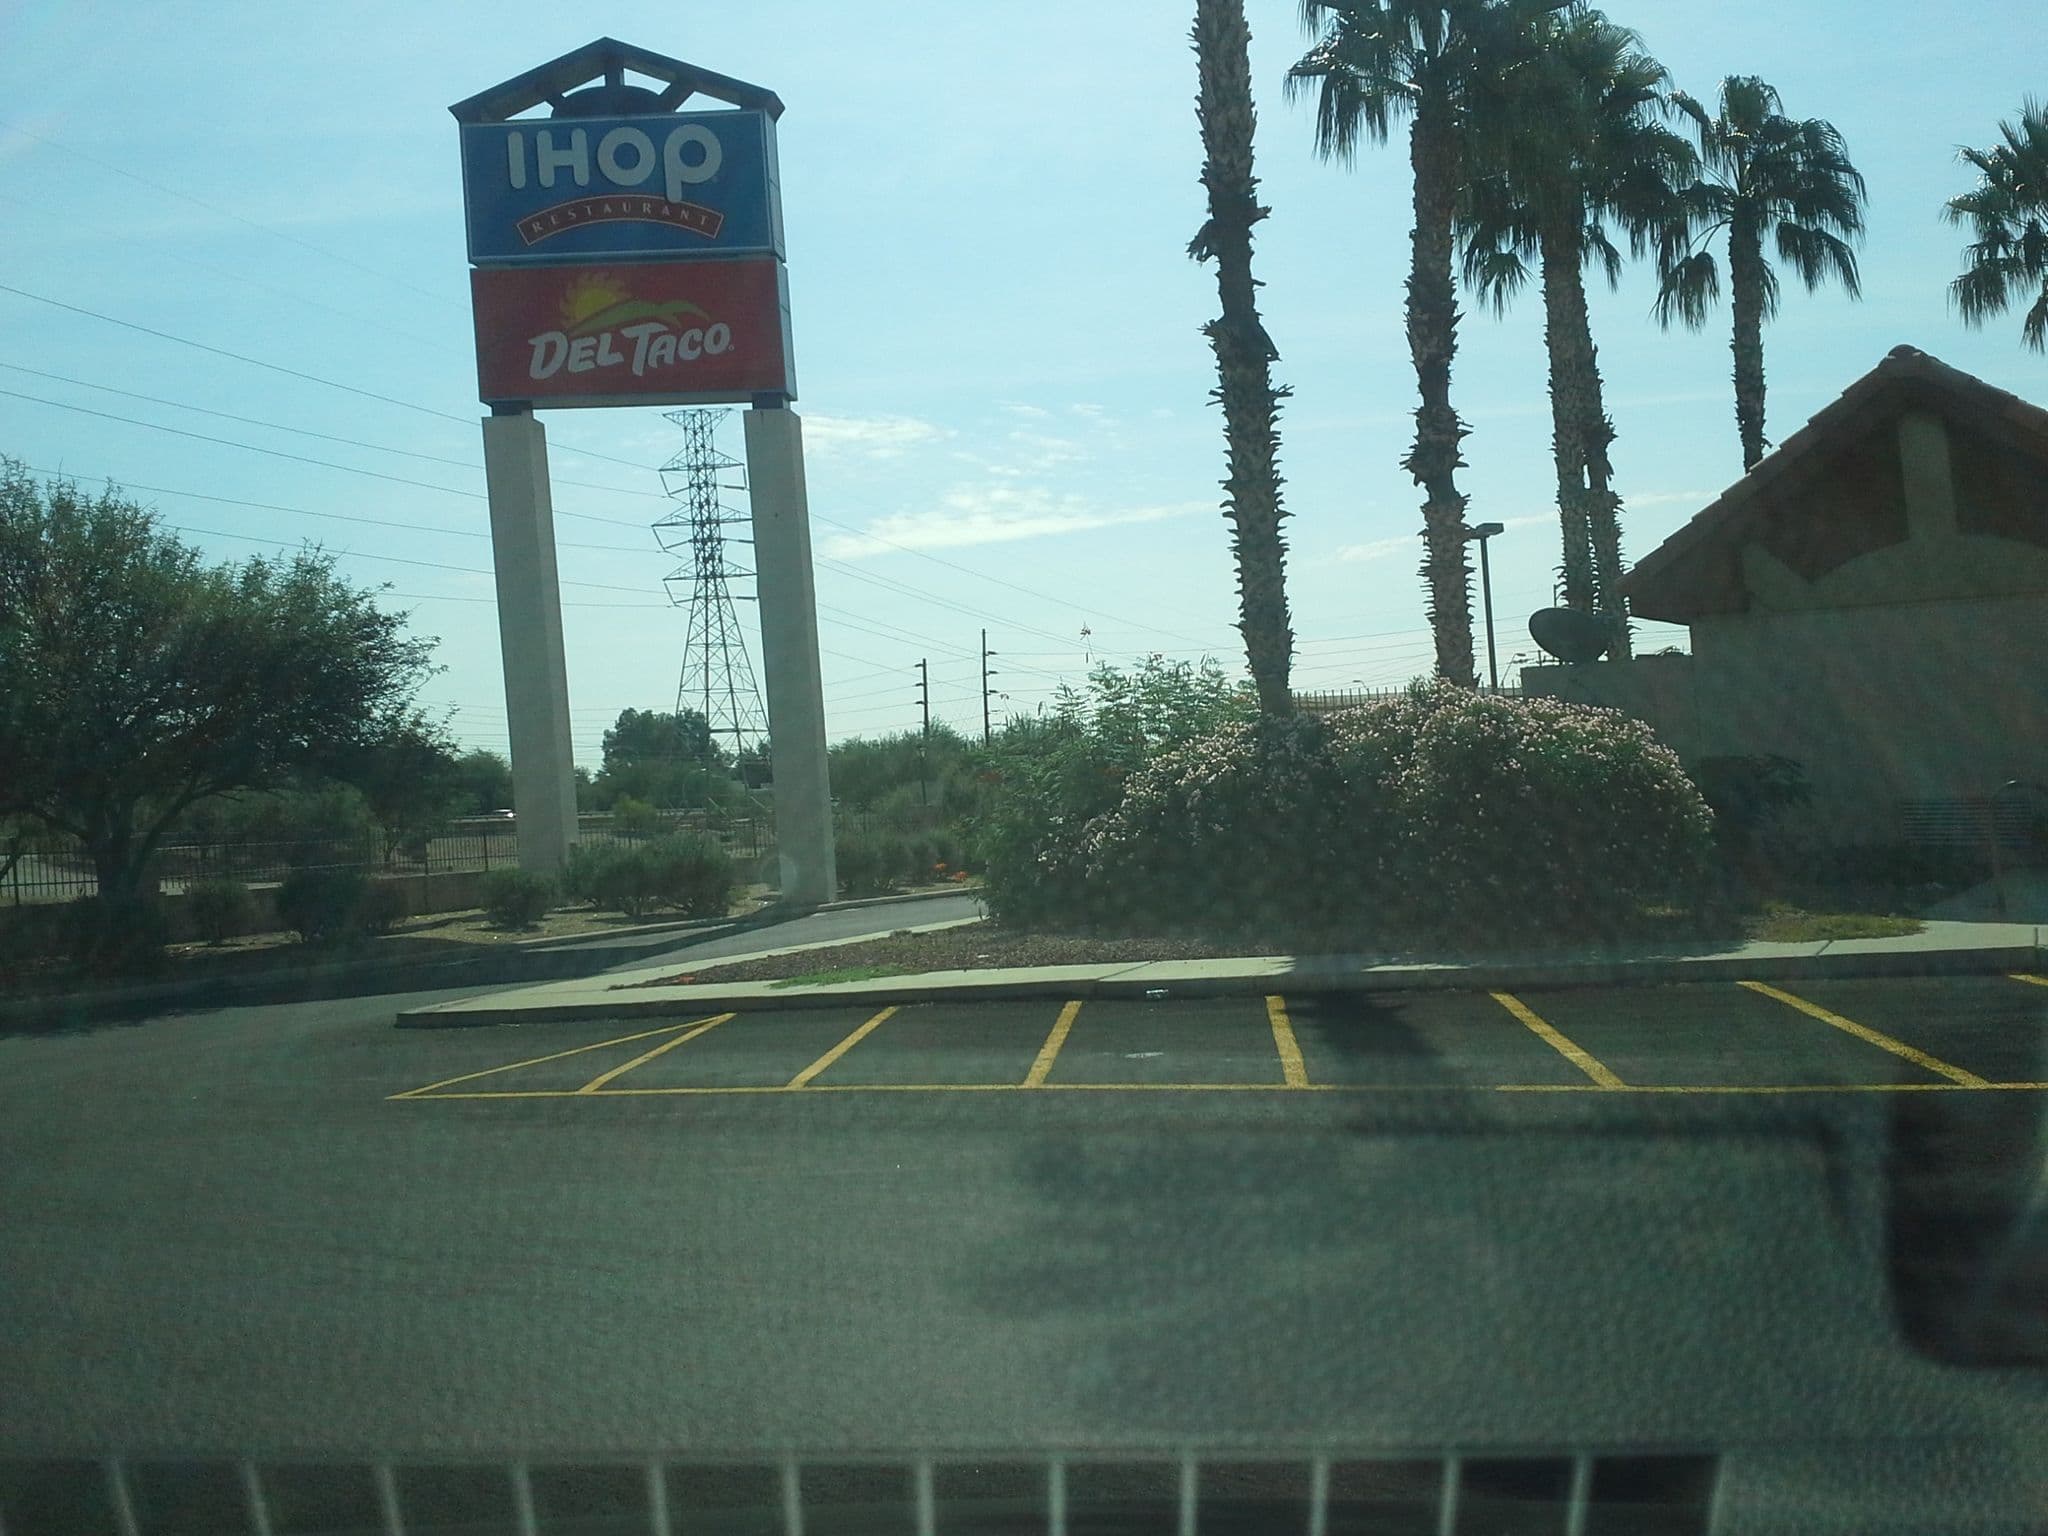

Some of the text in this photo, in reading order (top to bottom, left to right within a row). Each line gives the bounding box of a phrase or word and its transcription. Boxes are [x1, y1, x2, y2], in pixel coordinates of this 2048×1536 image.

[508, 125, 722, 203] IHOP
[532, 203, 709, 233] RESTAURANT
[528, 322, 731, 380] DEL TACO
